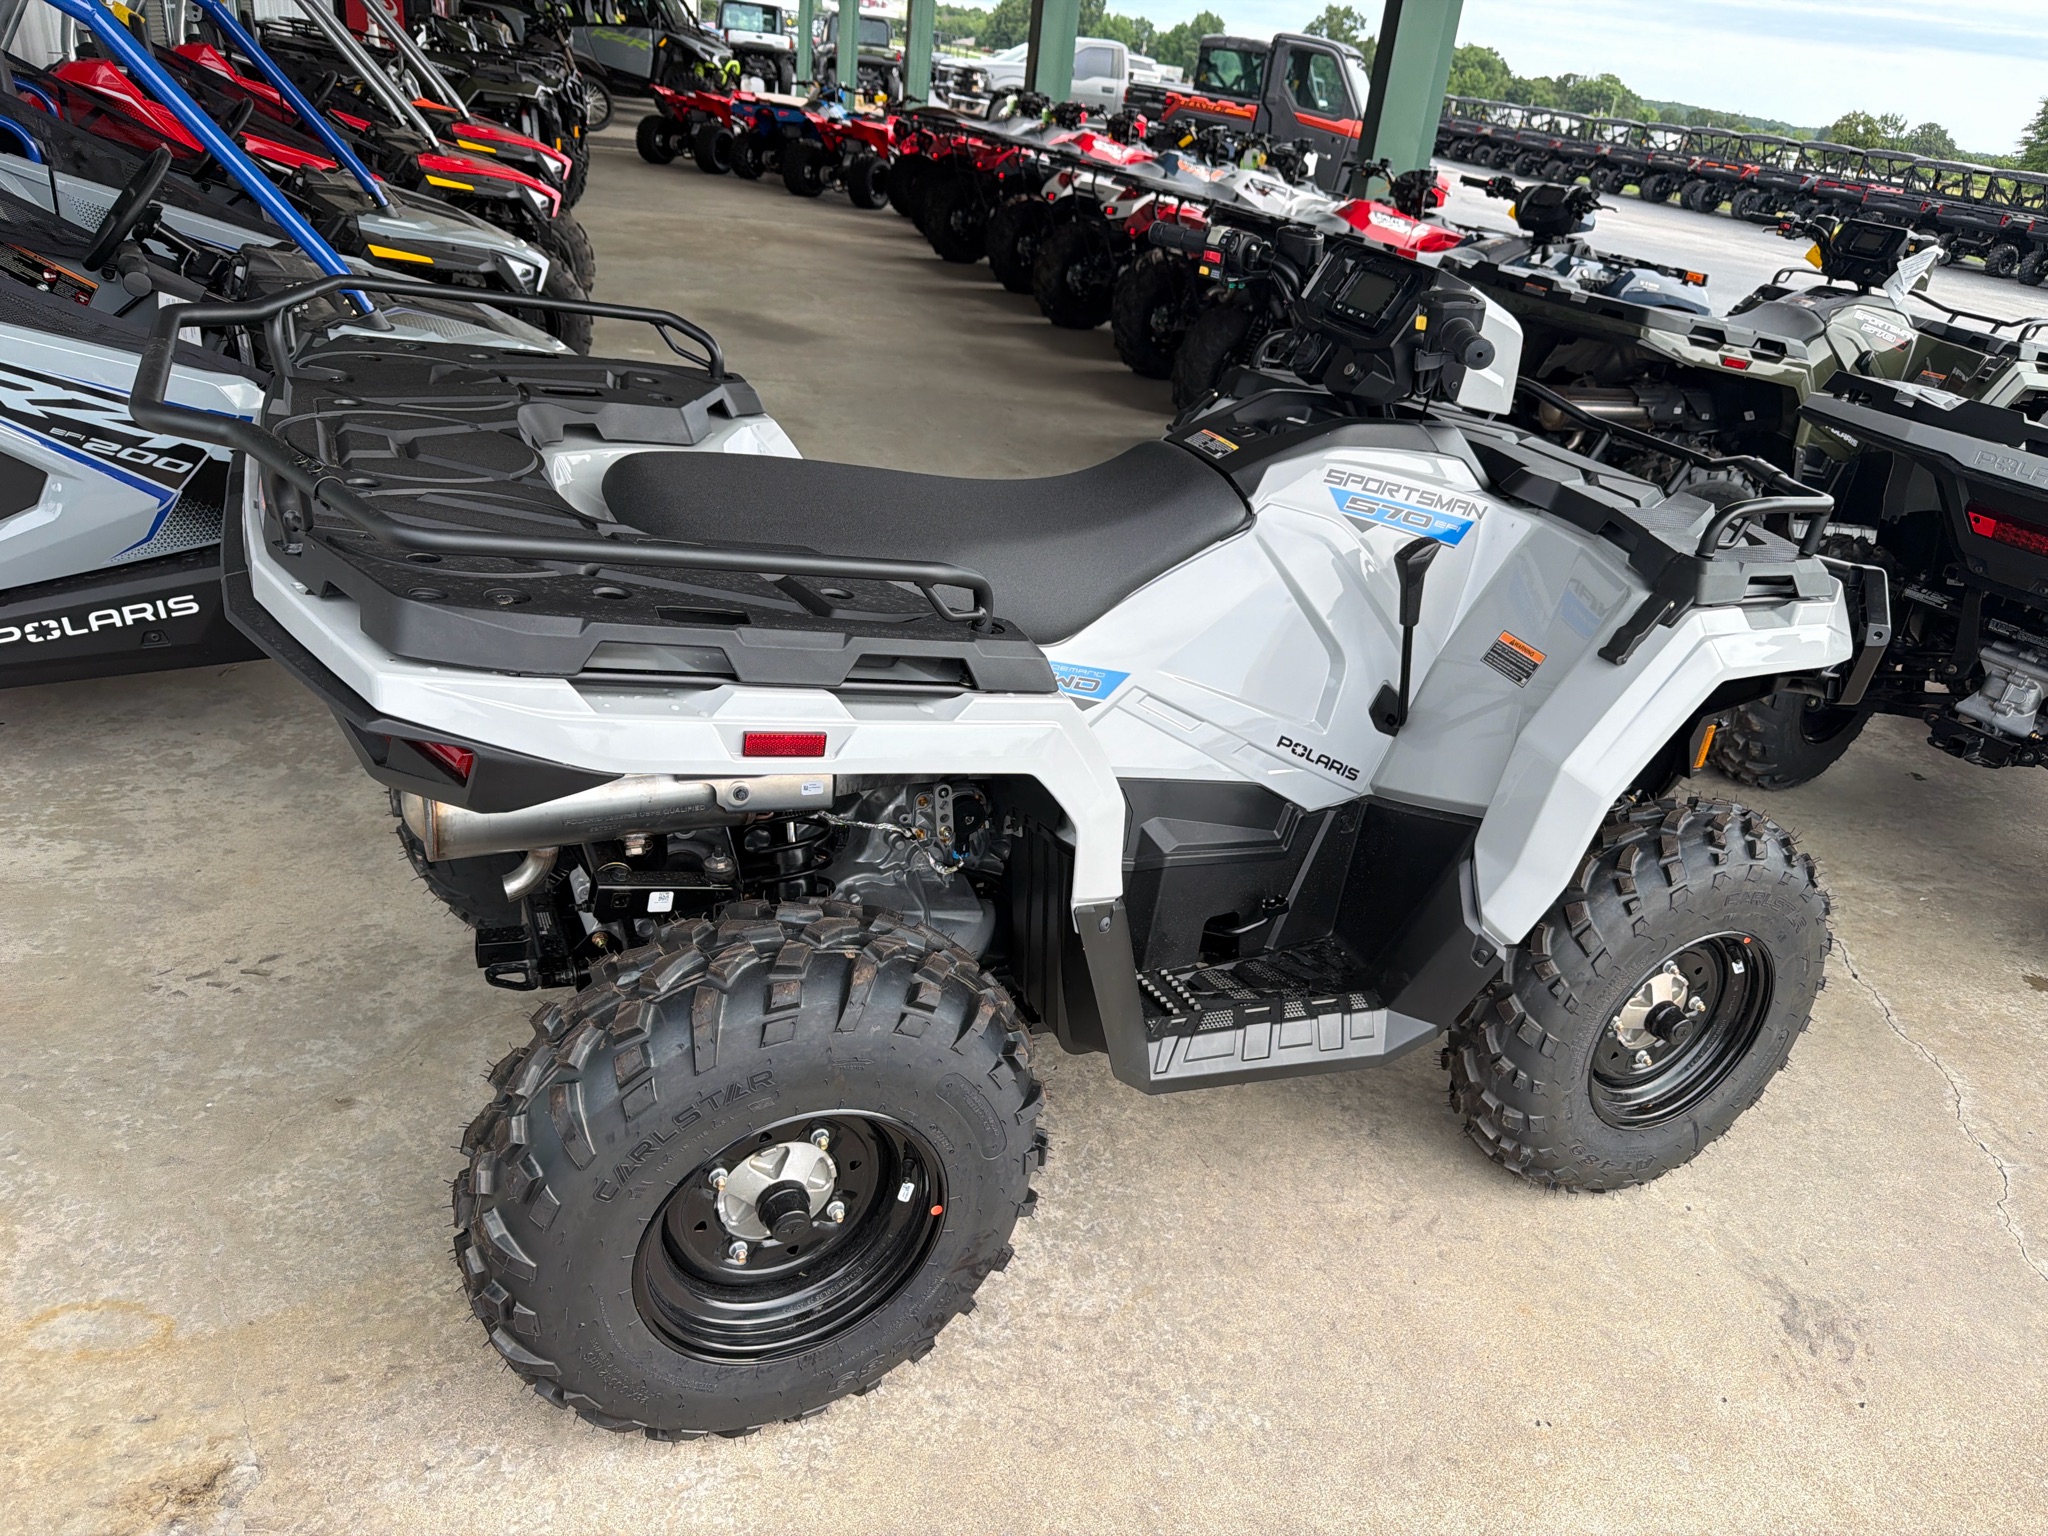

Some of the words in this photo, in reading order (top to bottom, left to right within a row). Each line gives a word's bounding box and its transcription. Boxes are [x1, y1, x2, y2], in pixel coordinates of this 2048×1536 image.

[1853, 309, 1918, 341] SPORTSMAN
[1861, 322, 1896, 343] 570
[49, 427, 86, 441] EFI
[82, 437, 194, 474] 200
[1323, 468, 1488, 520] SPORTSMAN
[1345, 496, 1432, 529] 570
[1434, 520, 1461, 533] EFI
[0, 594, 200, 643] POLARIS
[1514, 642, 1535, 658] WARNING
[1276, 735, 1360, 781] POLARIS
[663, 804, 706, 815] QUALIFIED
[593, 1069, 776, 1203] CARLSTAR
[692, 1129, 710, 1143] THE
